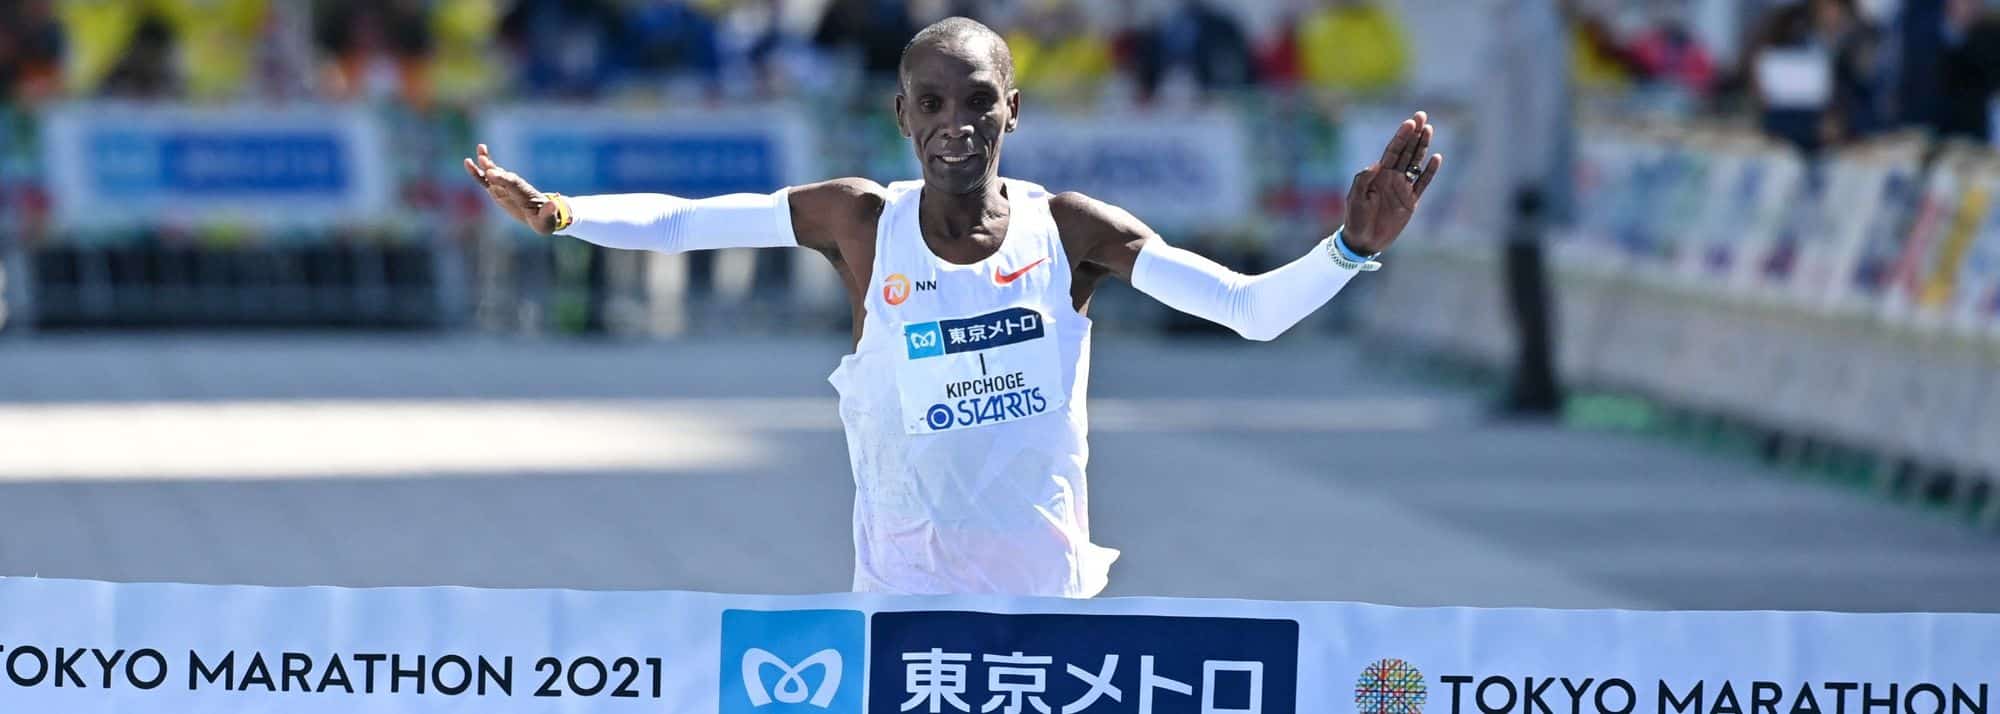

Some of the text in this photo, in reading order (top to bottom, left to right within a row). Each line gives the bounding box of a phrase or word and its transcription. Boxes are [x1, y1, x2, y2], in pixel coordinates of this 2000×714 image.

[915, 280, 937, 291] NN
[948, 314, 1038, 345] 東京メトロ
[946, 372, 1025, 399] KIPCHOGE
[0, 644, 662, 698] OKYO MARATHON 2021
[900, 647, 1264, 714] 東京メトロ
[1440, 675, 1989, 714] TOKYO MARATHON
